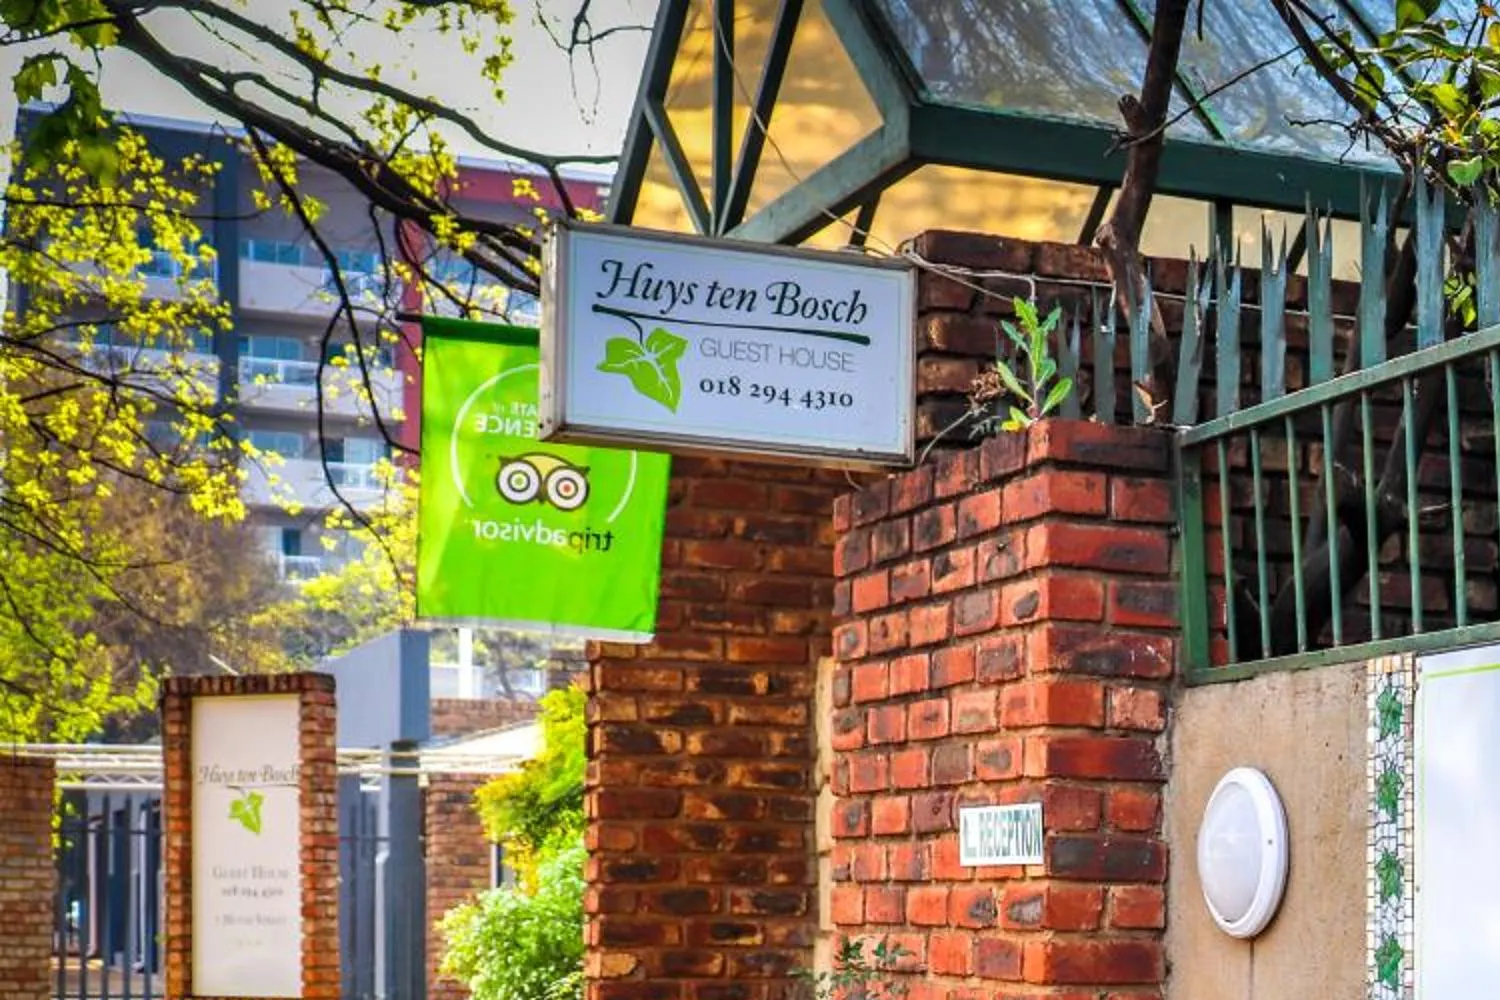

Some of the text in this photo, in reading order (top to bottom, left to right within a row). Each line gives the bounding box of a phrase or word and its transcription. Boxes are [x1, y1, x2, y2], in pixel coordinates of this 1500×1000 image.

[596, 259, 868, 326] Huys ten Bosch
[699, 338, 857, 373] GUEST HOUSE
[699, 377, 854, 410] 018 294 4310
[979, 809, 1041, 857] RECEPTION
